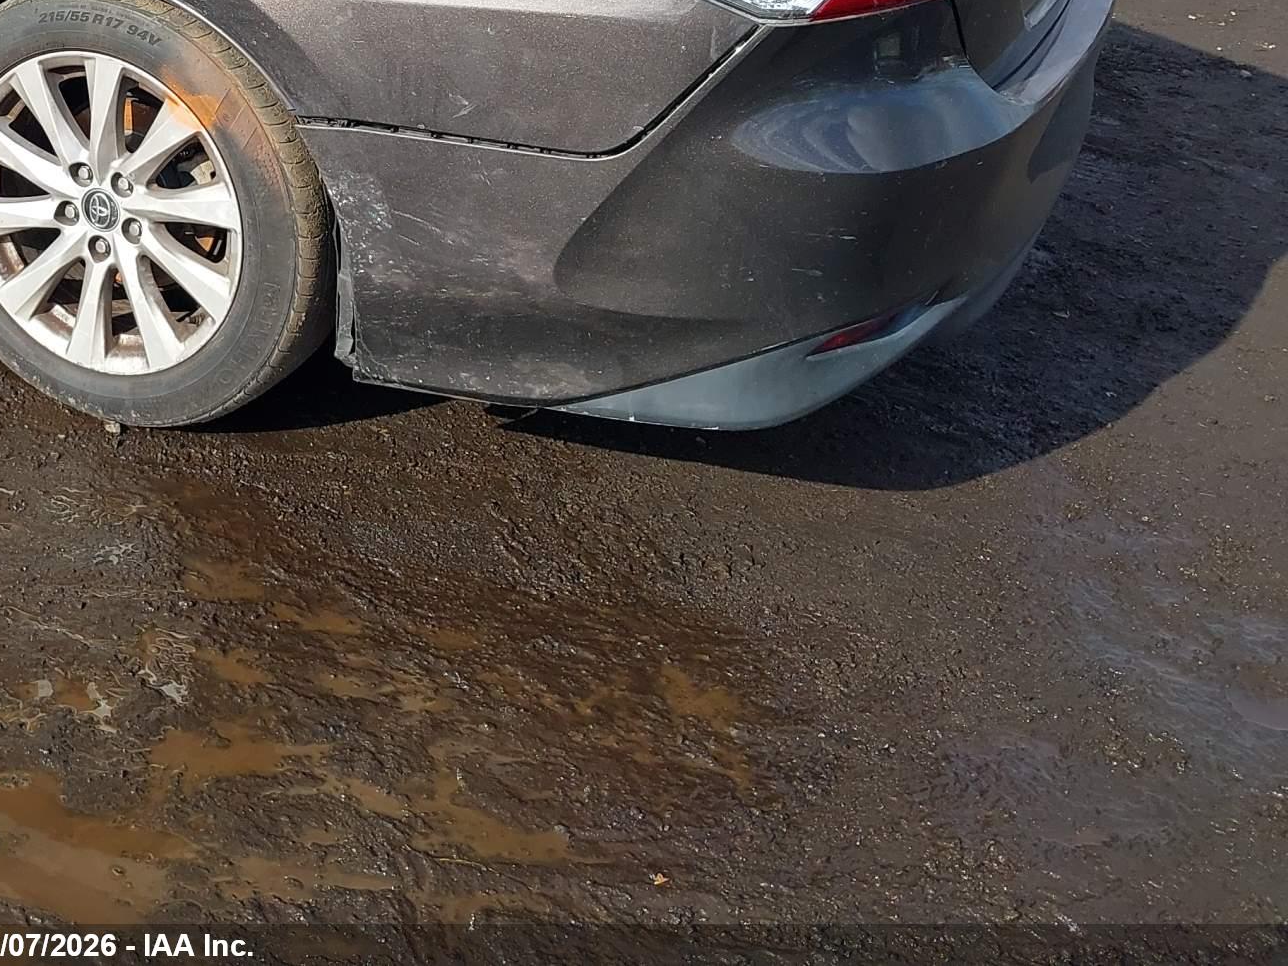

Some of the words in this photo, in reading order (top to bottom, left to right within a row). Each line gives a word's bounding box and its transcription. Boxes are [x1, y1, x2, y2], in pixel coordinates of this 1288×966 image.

[37, 9, 91, 24] 215/55
[91, 14, 124, 29] R17
[126, 24, 163, 46] 94V
